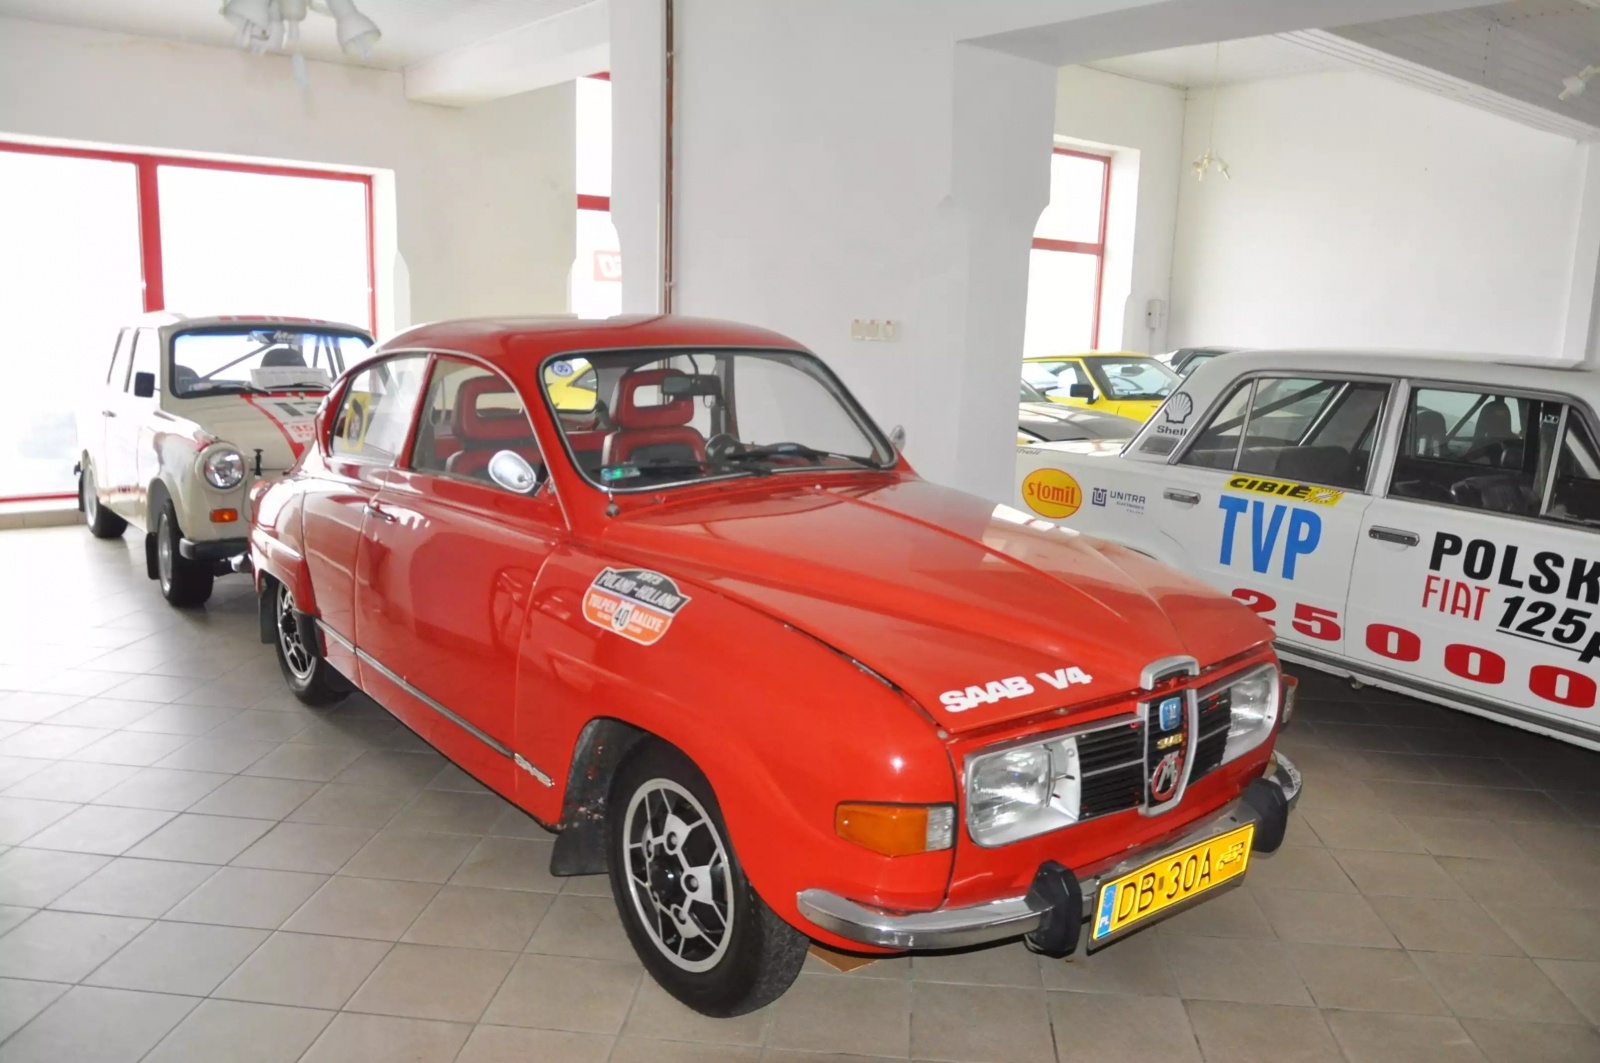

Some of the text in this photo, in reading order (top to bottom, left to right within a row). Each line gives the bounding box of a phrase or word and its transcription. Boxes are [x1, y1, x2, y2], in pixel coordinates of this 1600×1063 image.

[1156, 425, 1188, 436] Shell
[1028, 481, 1075, 504] stomil
[1110, 490, 1146, 504] UNITRA
[1219, 495, 1322, 580] TVP
[1429, 531, 1600, 605] POLSK
[1422, 575, 1491, 621] FIAT
[614, 607, 630, 627] 40
[939, 666, 1093, 712] SAAB V4
[1114, 847, 1211, 924] DB 30A
[1099, 916, 1110, 928] PL
